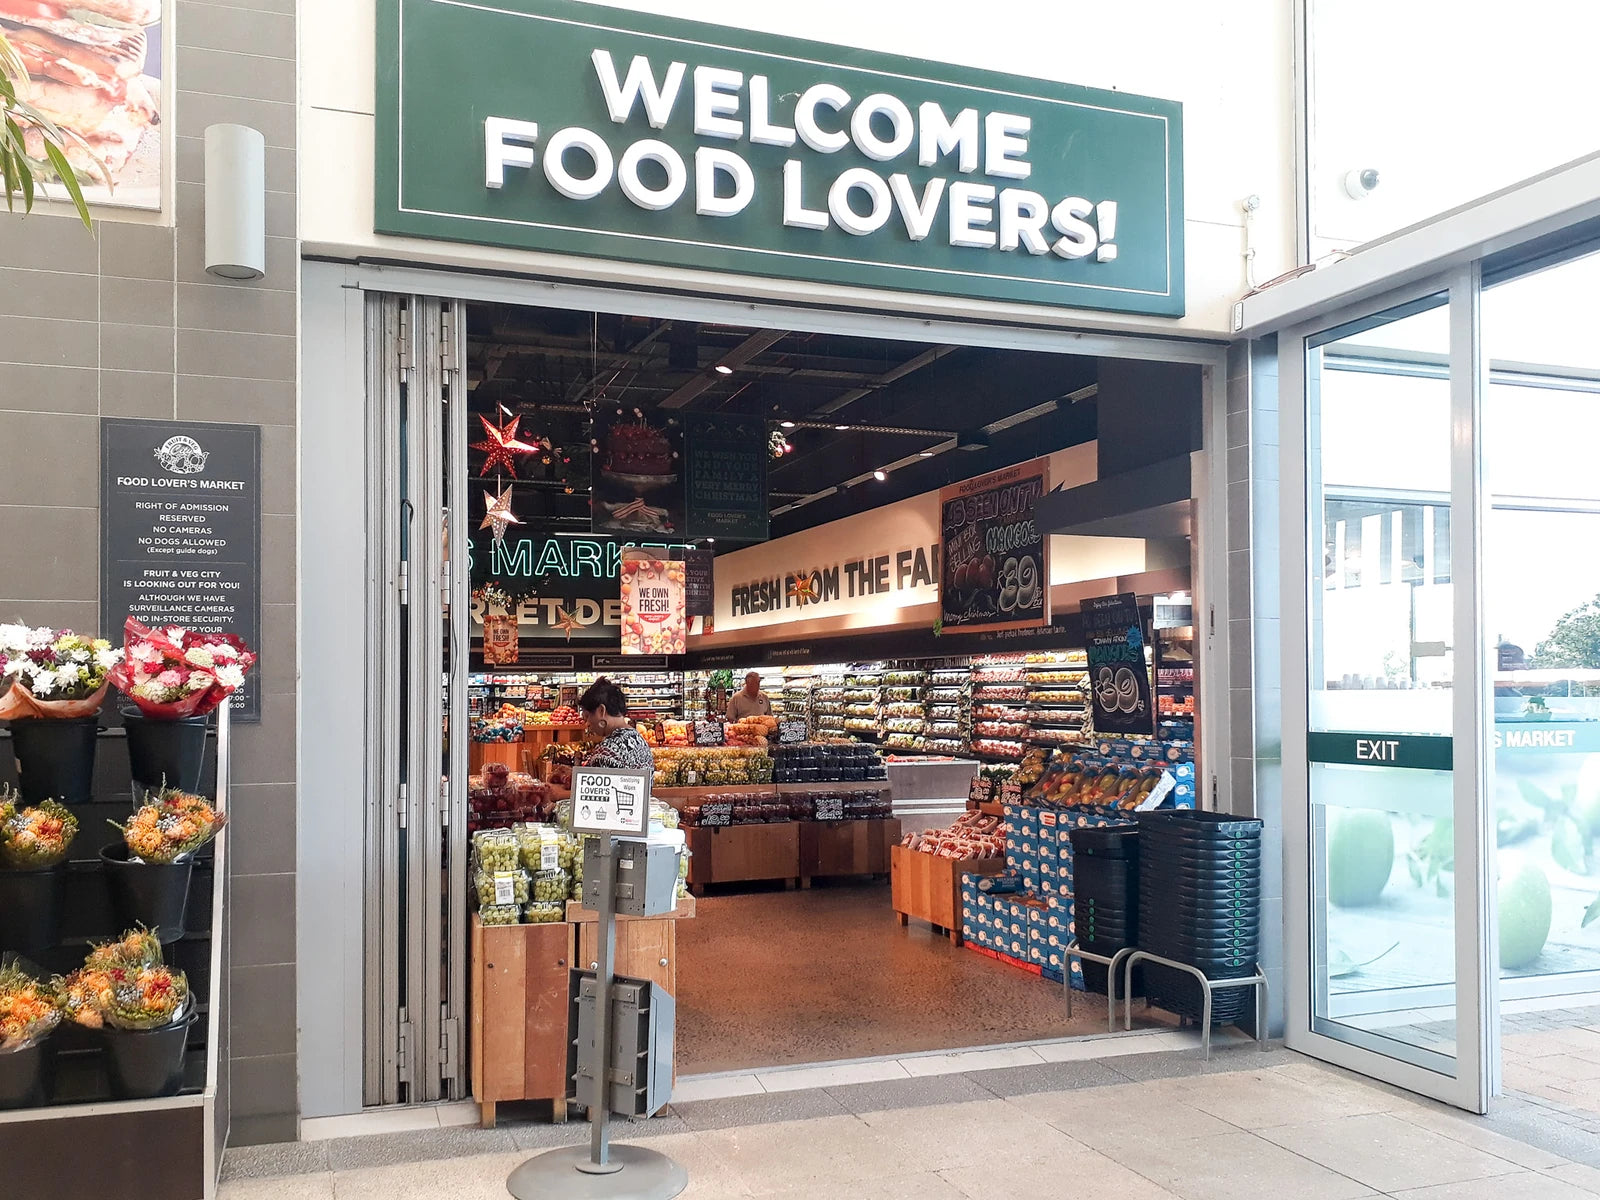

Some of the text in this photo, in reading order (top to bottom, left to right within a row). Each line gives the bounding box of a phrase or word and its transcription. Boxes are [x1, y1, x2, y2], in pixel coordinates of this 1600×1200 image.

[591, 48, 1032, 180] WELCOME
[484, 116, 1119, 264] FOOD LOVERS!
[117, 476, 245, 490] FOOD LOVER'S MARKET
[695, 491, 758, 502] CHRISTMAS
[135, 502, 229, 512] RIGHT OF ADMISSION
[159, 514, 206, 523] RESERVED
[153, 526, 212, 535] NO CAMERAS
[138, 537, 226, 547] NO DOGS ALLOWED
[147, 546, 218, 556] (Except guide dogs)
[144, 570, 221, 579] FRUIT & VEG CITY
[123, 580, 240, 589] IS LOOKING OUT FOR YOU!
[732, 577, 780, 617] FRESH
[844, 555, 889, 598] THE
[139, 594, 225, 602] ALTHOUGH WE HAVE
[639, 588, 669, 598] WE OWN
[129, 604, 235, 613] SURVEILLANCE CAMERAS
[639, 599, 669, 612] FRESH!
[151, 615, 190, 623] IN-STORE
[192, 615, 234, 624] SECURITY,
[1505, 730, 1576, 747] MARKET
[1356, 739, 1399, 761] EXIT
[581, 776, 611, 786] FOOD
[580, 787, 610, 795] LOVER'S
